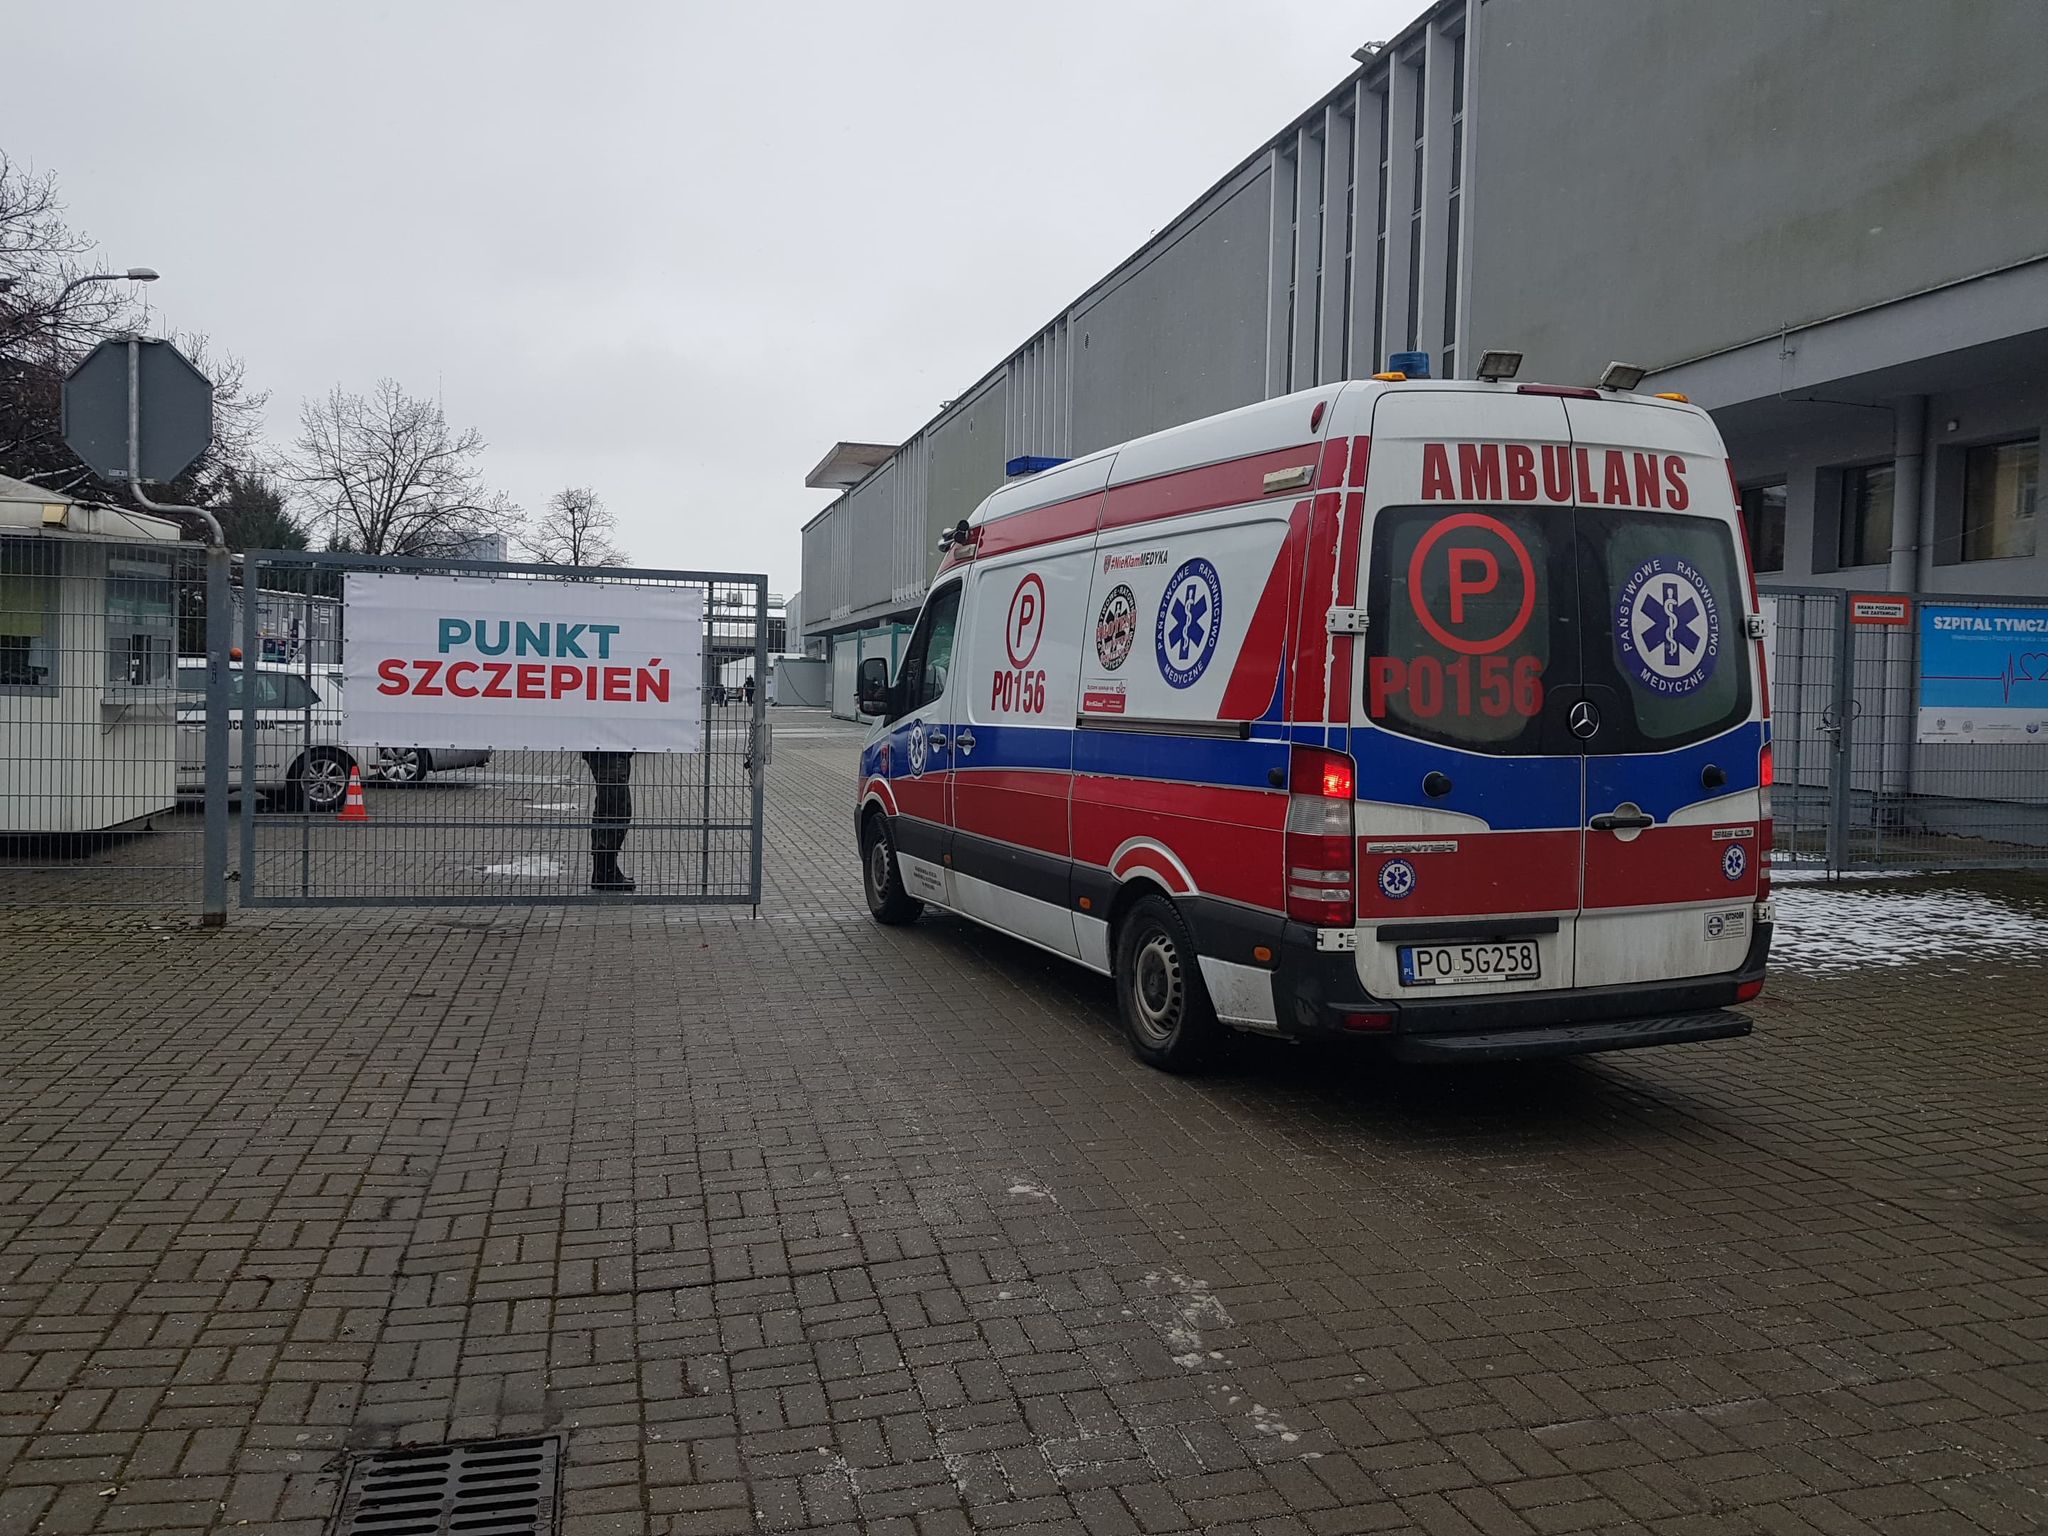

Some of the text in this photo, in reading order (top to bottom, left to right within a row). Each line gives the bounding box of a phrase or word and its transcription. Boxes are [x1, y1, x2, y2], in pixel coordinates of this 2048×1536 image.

[1421, 443, 1689, 511] AMBULANS
[1448, 548, 1499, 624] P
[1016, 594, 1035, 648] P
[1198, 563, 1220, 648] RATOWNICTWO
[1617, 560, 1719, 656] PAŃSTWOWE RATOWNICTWO
[1933, 616, 1993, 631] SZPITAL
[438, 618, 620, 660] PUNKT
[377, 658, 670, 703] SZCZEPIEŃ
[1164, 660, 1204, 684] MEDYCZNE
[1640, 668, 1706, 693] MEDYCZNE
[227, 719, 276, 730] OCONA
[1367, 842, 1457, 853] SPRINTER
[1403, 967, 1413, 976] PL
[1416, 945, 1533, 976] PO 5G258
